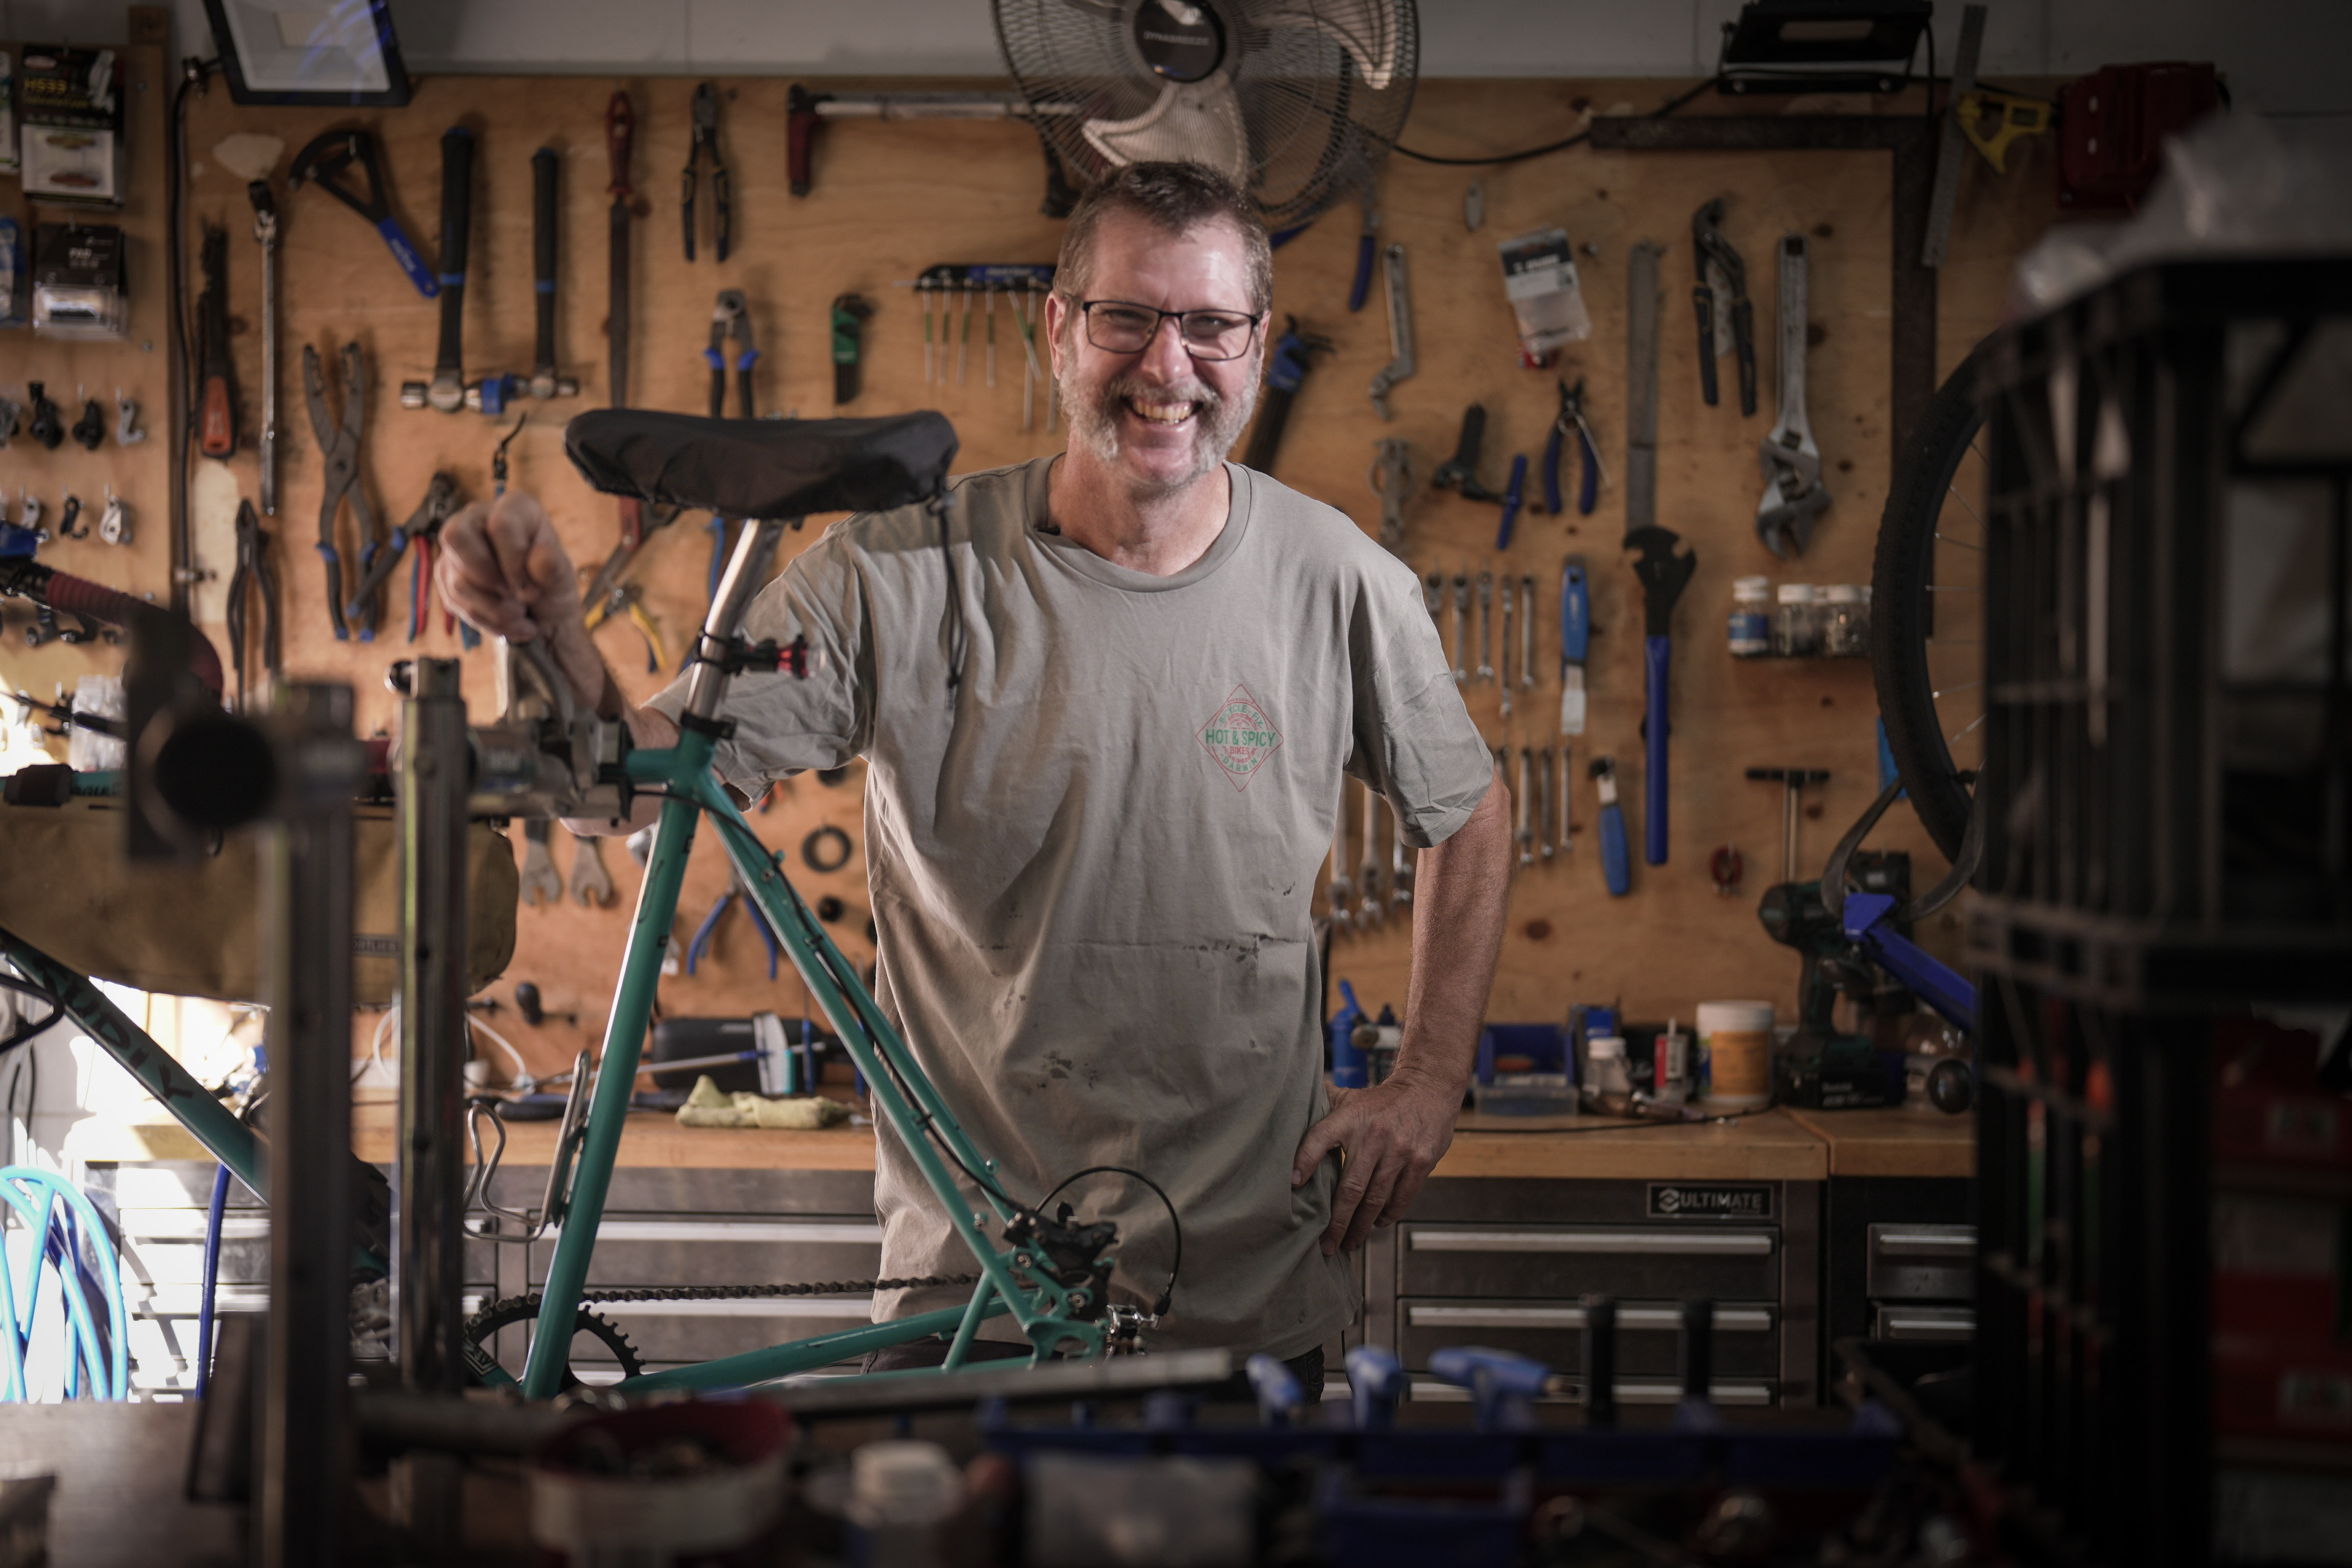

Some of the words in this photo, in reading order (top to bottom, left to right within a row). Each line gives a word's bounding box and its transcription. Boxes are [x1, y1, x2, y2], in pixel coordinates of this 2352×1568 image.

[1219, 704, 1247, 724] BICYCLE
[1252, 712, 1263, 727] FIX
[1206, 729, 1229, 744] HOT
[1233, 730, 1239, 745] &
[1242, 731, 1276, 746] SPICY
[1230, 746, 1250, 754] BIKES
[1222, 756, 1258, 772] DARWIN
[1681, 1192, 1762, 1209] ULTIMATE
